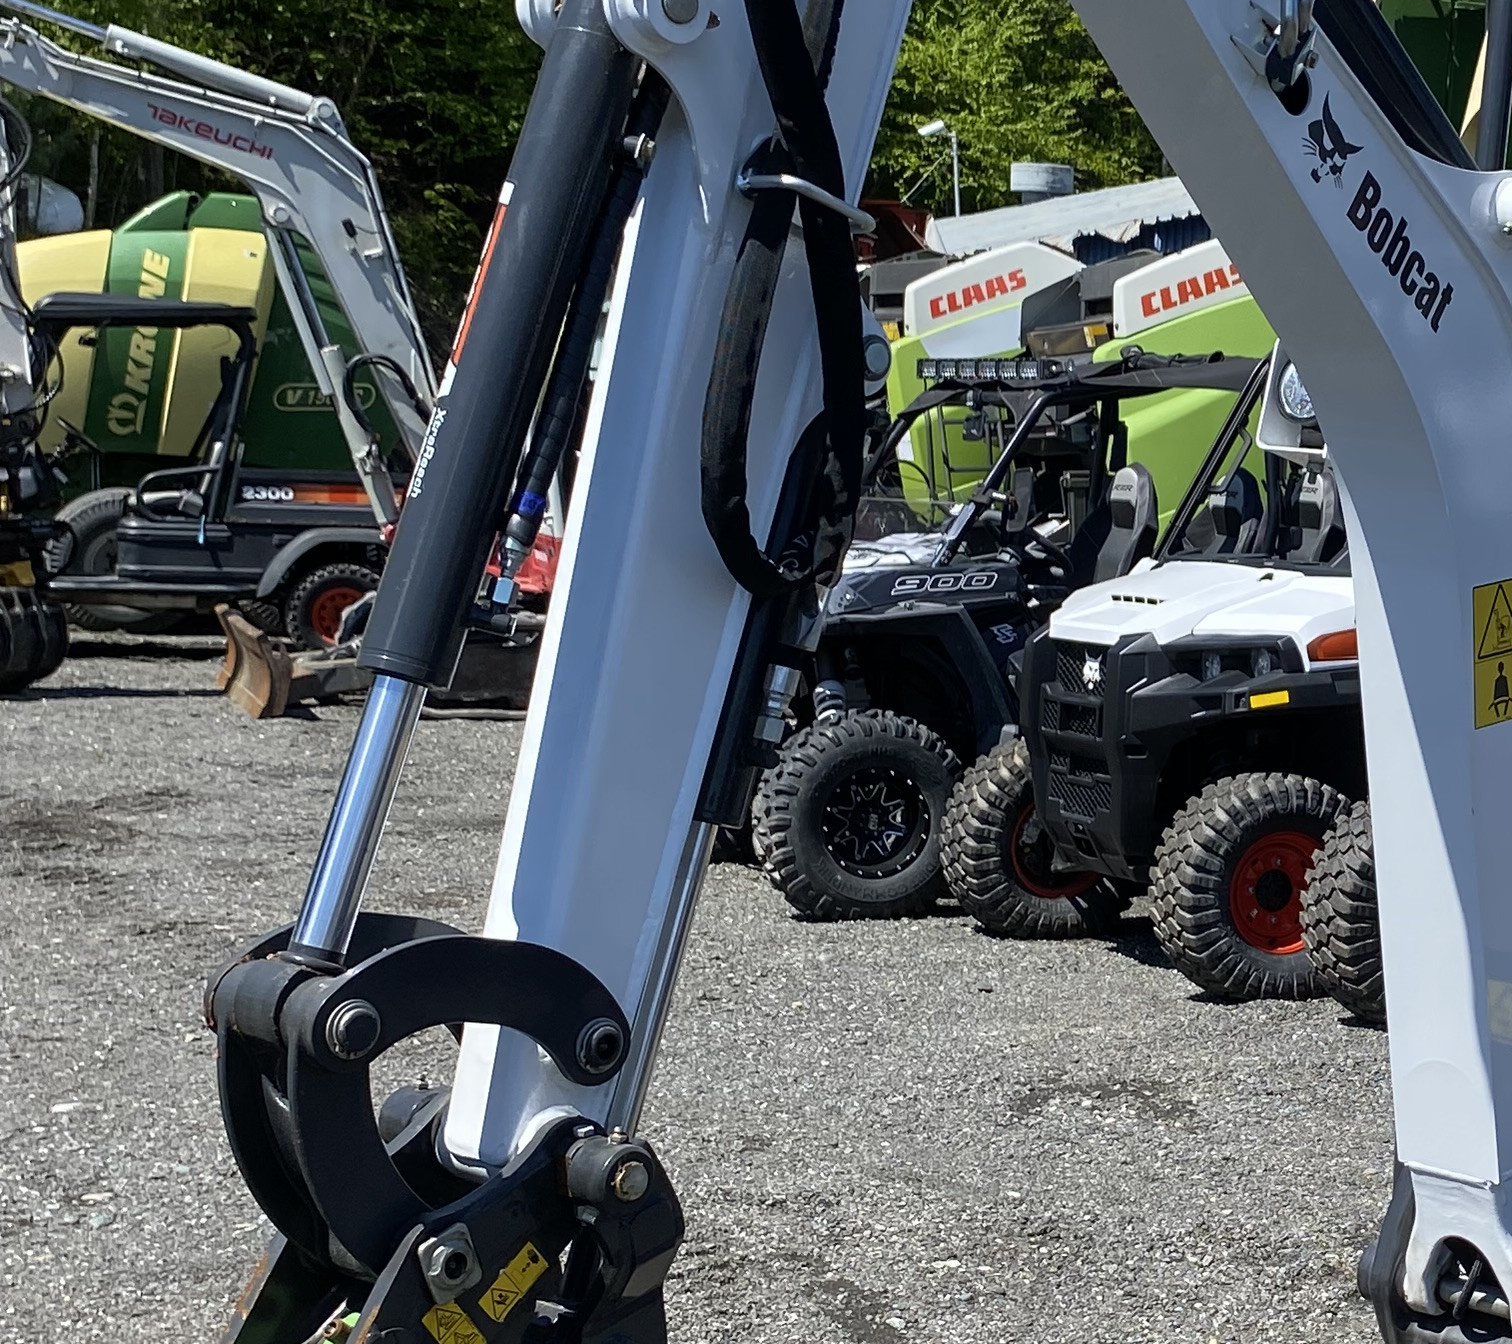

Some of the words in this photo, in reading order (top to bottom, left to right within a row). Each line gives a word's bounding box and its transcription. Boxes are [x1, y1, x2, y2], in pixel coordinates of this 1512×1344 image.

[1346, 170, 1454, 334] Bobcat
[929, 268, 1027, 320] CLAAS
[1140, 264, 1243, 319] CLAAS
[410, 406, 448, 498] XtraReach
[241, 485, 294, 501] 2300
[891, 571, 998, 596] 900
